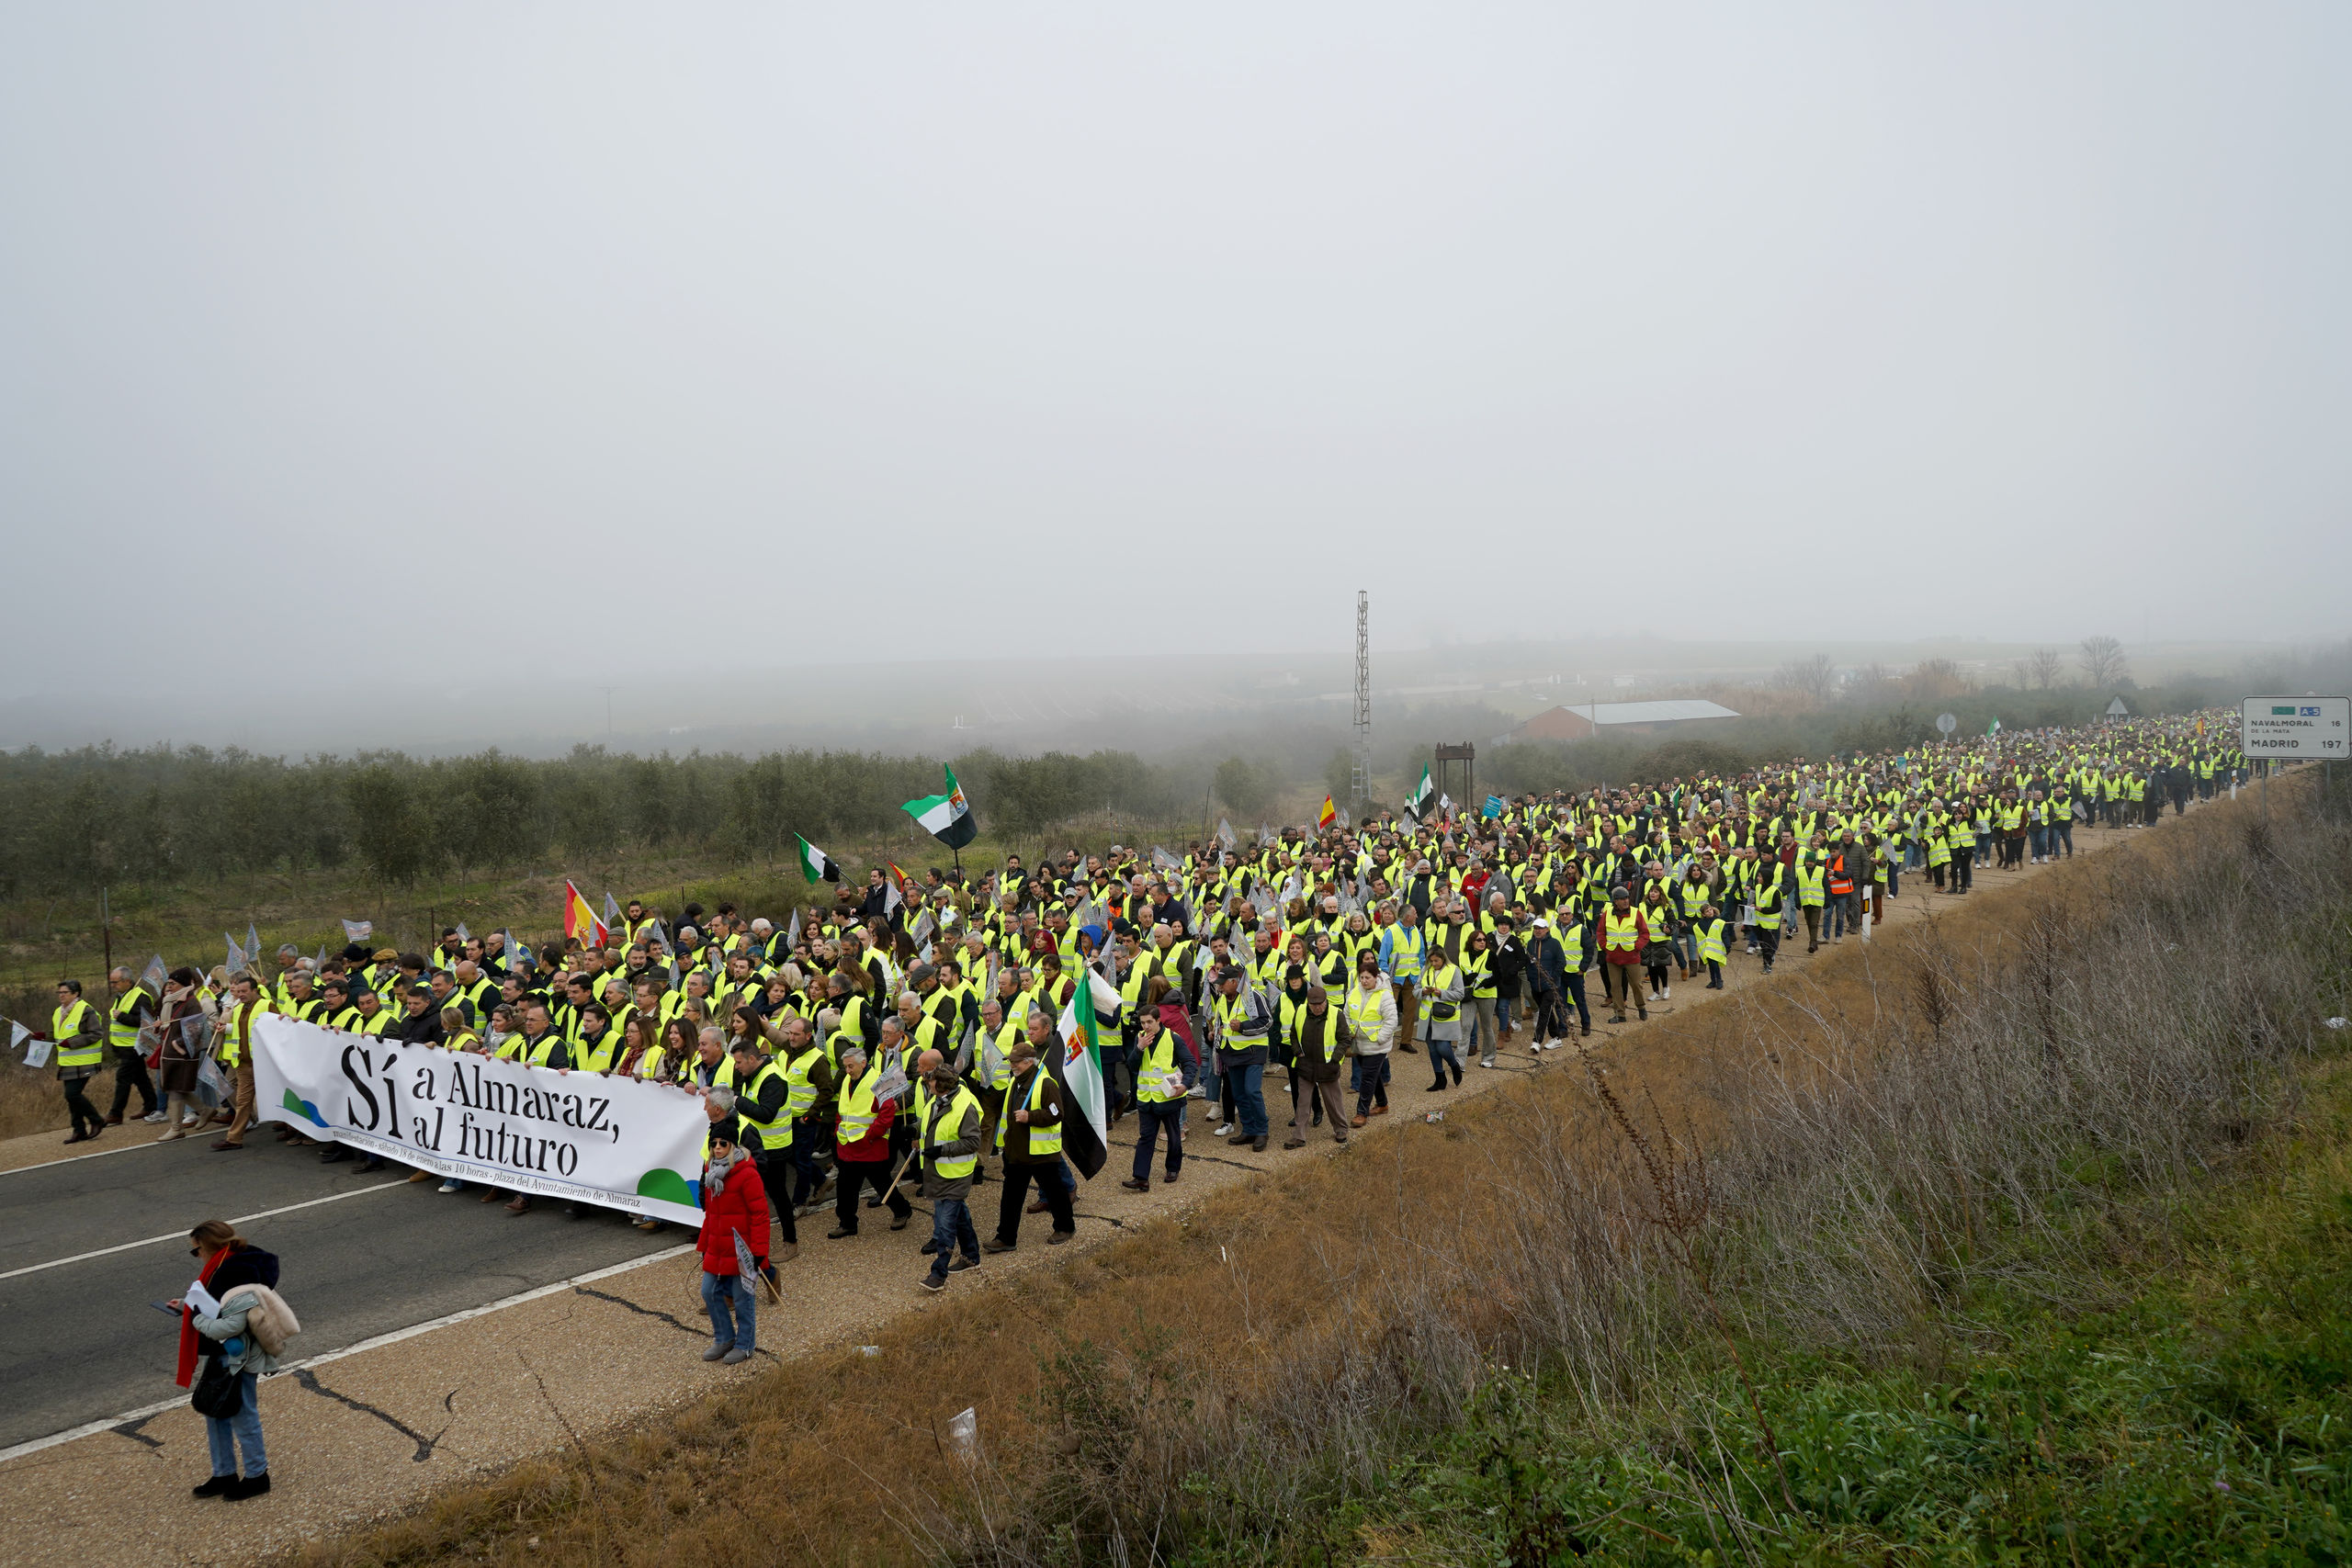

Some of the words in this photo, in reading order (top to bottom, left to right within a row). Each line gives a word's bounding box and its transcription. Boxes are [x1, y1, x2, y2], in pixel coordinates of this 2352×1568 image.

[2251, 739, 2299, 748] MADRID
[2322, 740, 2342, 749] 197
[341, 1044, 402, 1140] Sí
[413, 1067, 436, 1101] a
[447, 1061, 619, 1144] Almaraz,
[333, 1130, 375, 1148] manifestación
[378, 1142, 399, 1156] sábado
[399, 1146, 407, 1158] 18
[407, 1151, 415, 1161] de
[416, 1155, 434, 1167] enero
[439, 1160, 452, 1172] las
[455, 1163, 465, 1173] 10
[466, 1165, 489, 1179] horas
[492, 1171, 515, 1184] plaza
[516, 1176, 529, 1187] del
[531, 1179, 592, 1199] Ayuntamiento
[593, 1190, 604, 1201] de
[605, 1192, 640, 1208] Almaraz
[413, 1107, 444, 1152] al
[457, 1111, 578, 1177] futuro
